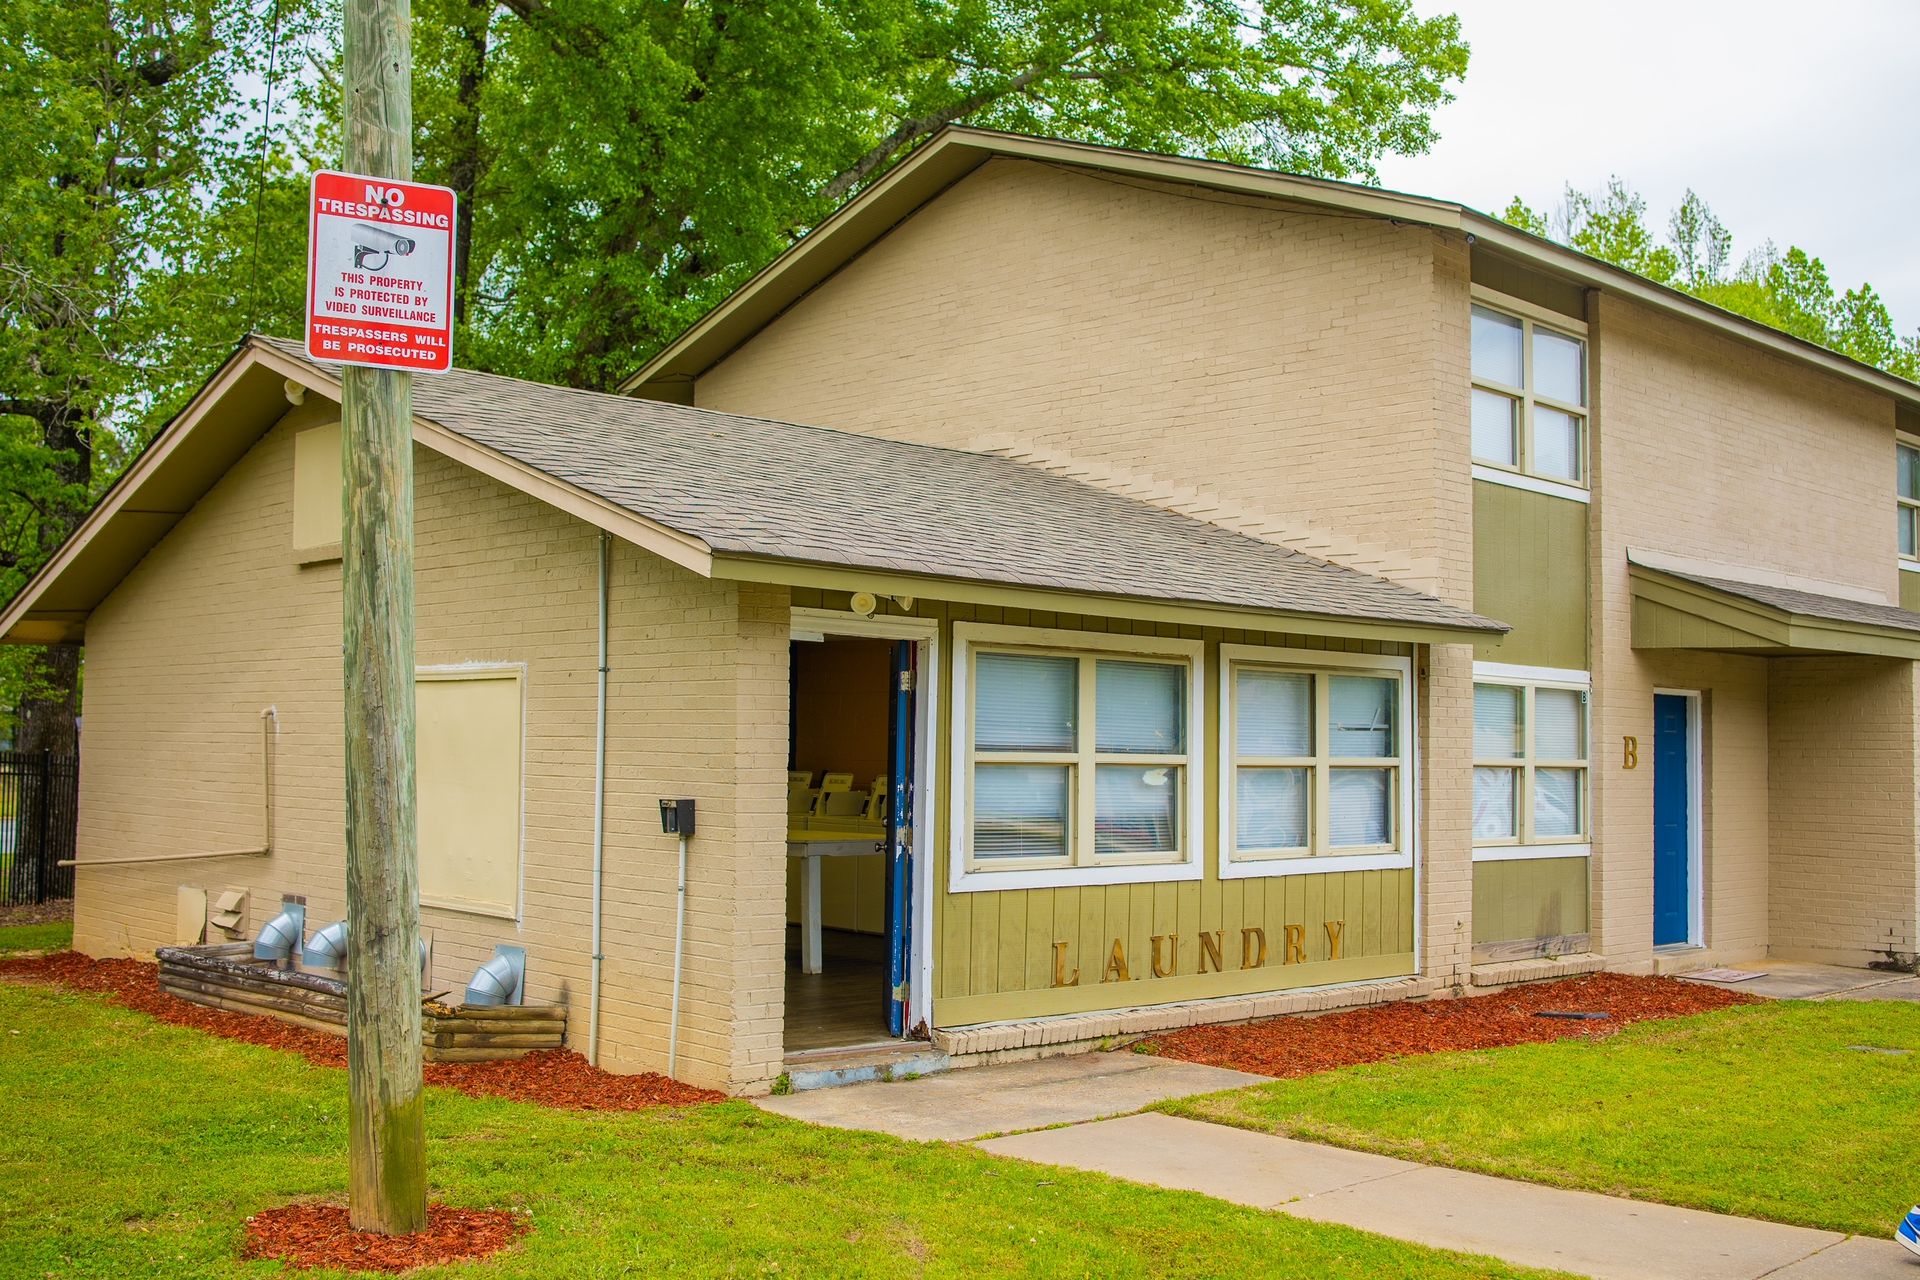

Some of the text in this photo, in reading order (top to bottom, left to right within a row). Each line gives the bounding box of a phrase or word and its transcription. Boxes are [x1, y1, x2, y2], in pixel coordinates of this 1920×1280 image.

[365, 185, 404, 207] NO
[319, 198, 448, 228] TRESPASSING
[341, 272, 423, 291] THIS PROPERTY
[335, 287, 428, 306] IS PROTECTED BY
[325, 301, 436, 322] VIDEO SURVEILLANCE
[313, 324, 446, 347] TRESPASSERS WILL
[323, 340, 436, 361] BE PROSECUTED
[1622, 735, 1638, 769] B
[1050, 919, 1346, 988] LAUNDRY
